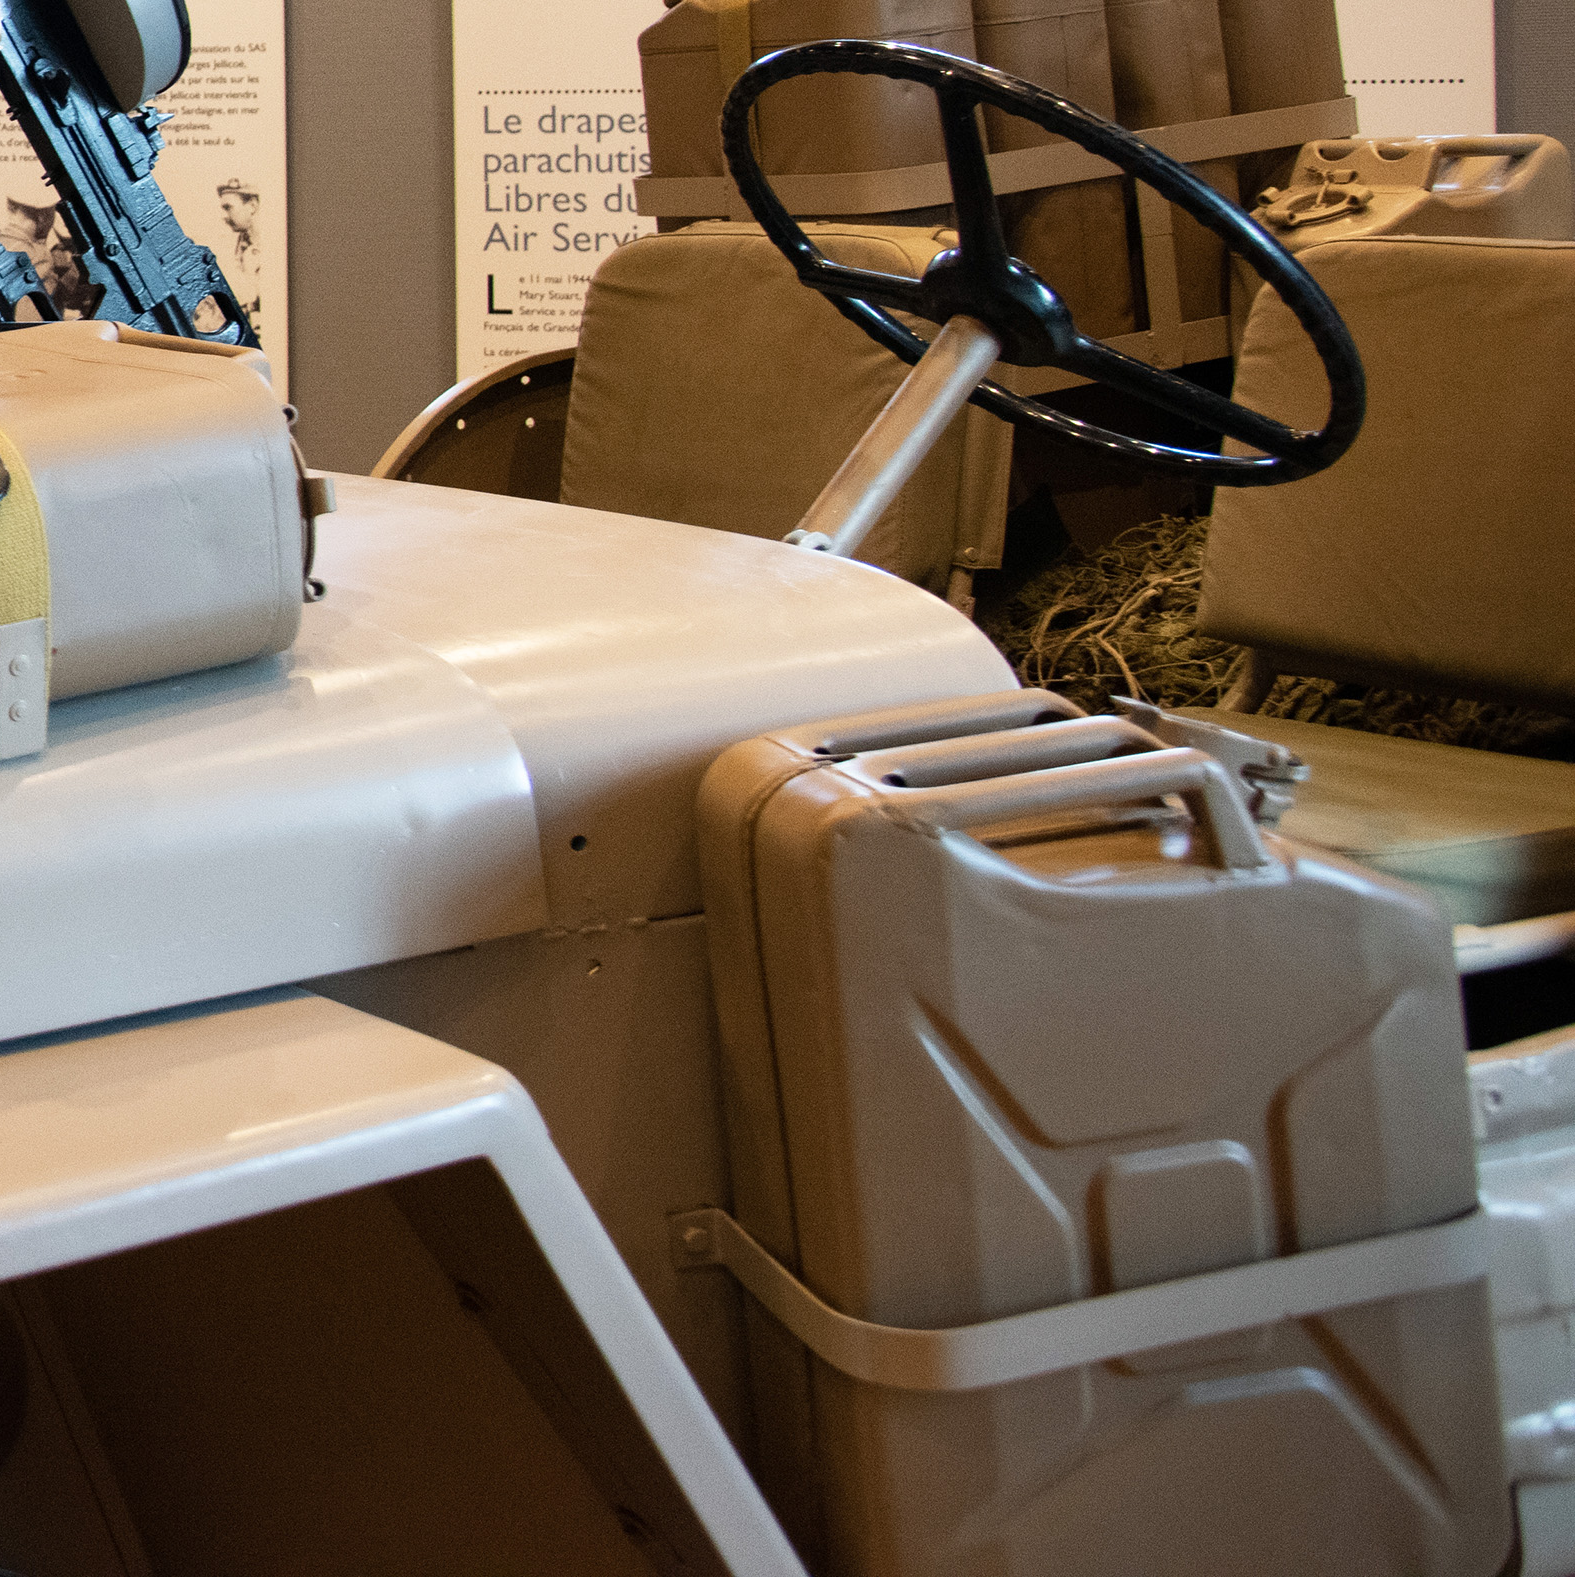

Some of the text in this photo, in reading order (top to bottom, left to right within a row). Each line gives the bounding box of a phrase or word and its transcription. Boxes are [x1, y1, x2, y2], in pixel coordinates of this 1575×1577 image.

[234, 43, 267, 52] du SAS
[483, 106, 522, 133] Le
[484, 145, 652, 181] parachutis
[485, 184, 588, 212] Libres
[483, 222, 537, 251] Air
[544, 275, 562, 283] mai
[519, 290, 583, 301] Mary Stuart,
[519, 306, 556, 315] Service
[483, 322, 524, 332] Français
[527, 323, 540, 332] de
